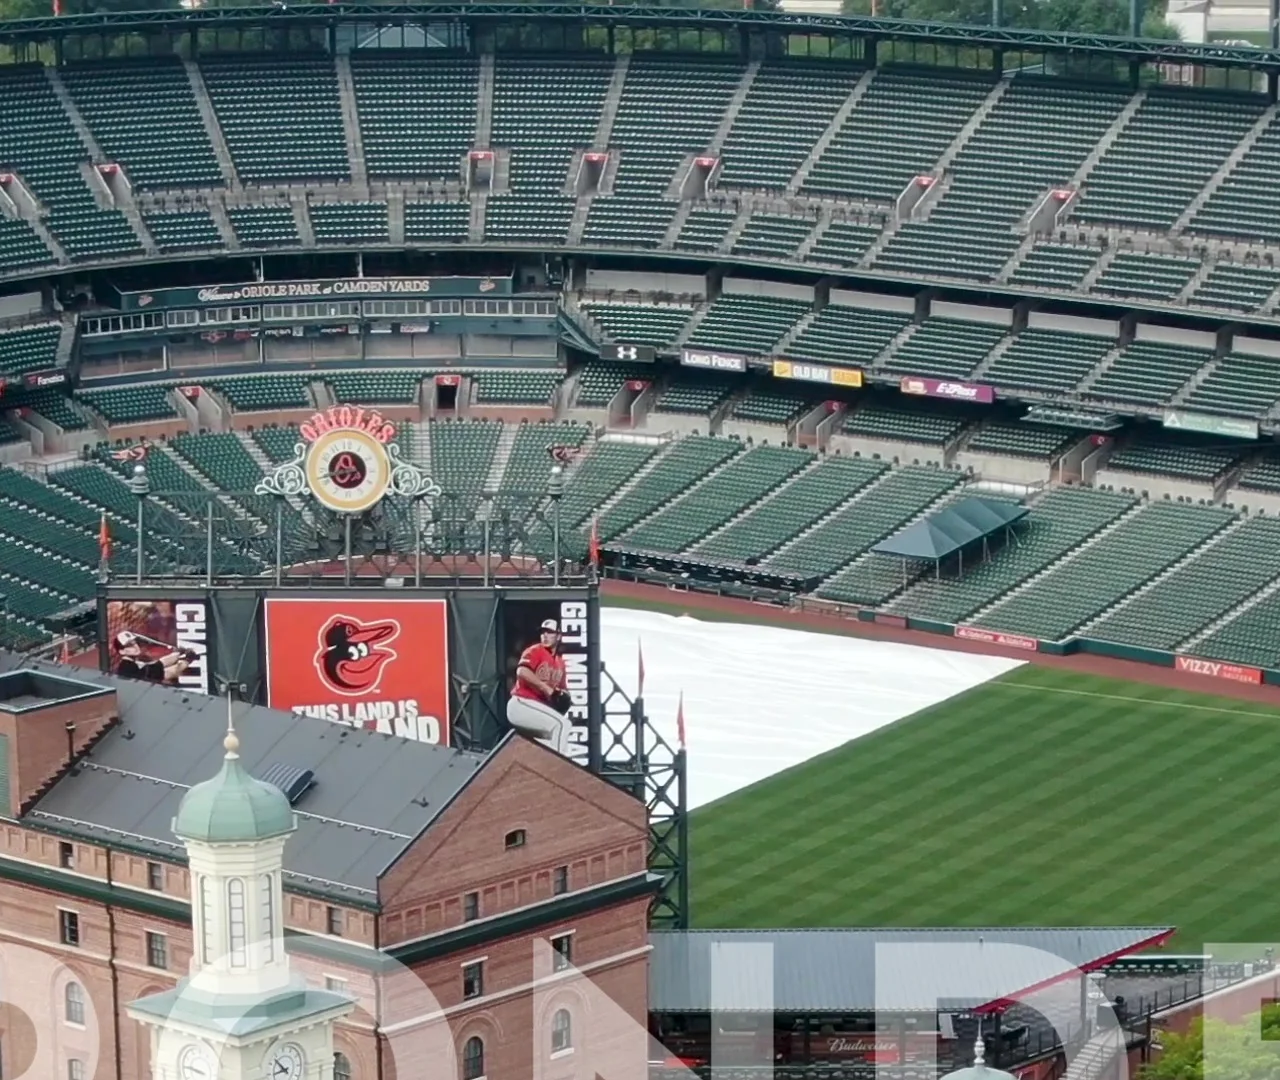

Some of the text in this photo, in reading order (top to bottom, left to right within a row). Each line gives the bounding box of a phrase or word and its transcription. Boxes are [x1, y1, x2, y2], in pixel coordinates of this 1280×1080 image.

[242, 285, 288, 298] ORIOLE
[288, 283, 321, 296] PARK
[333, 281, 388, 294] CAMDEN
[389, 280, 429, 292] YARDS
[37, 375, 65, 386] Fanatics
[300, 405, 396, 444] ORIOLES
[561, 602, 587, 648] GET
[1180, 657, 1222, 676] VIZZY
[342, 701, 396, 721] LAND
[399, 699, 418, 717] IS
[826, 1037, 898, 1052] Budweiser
